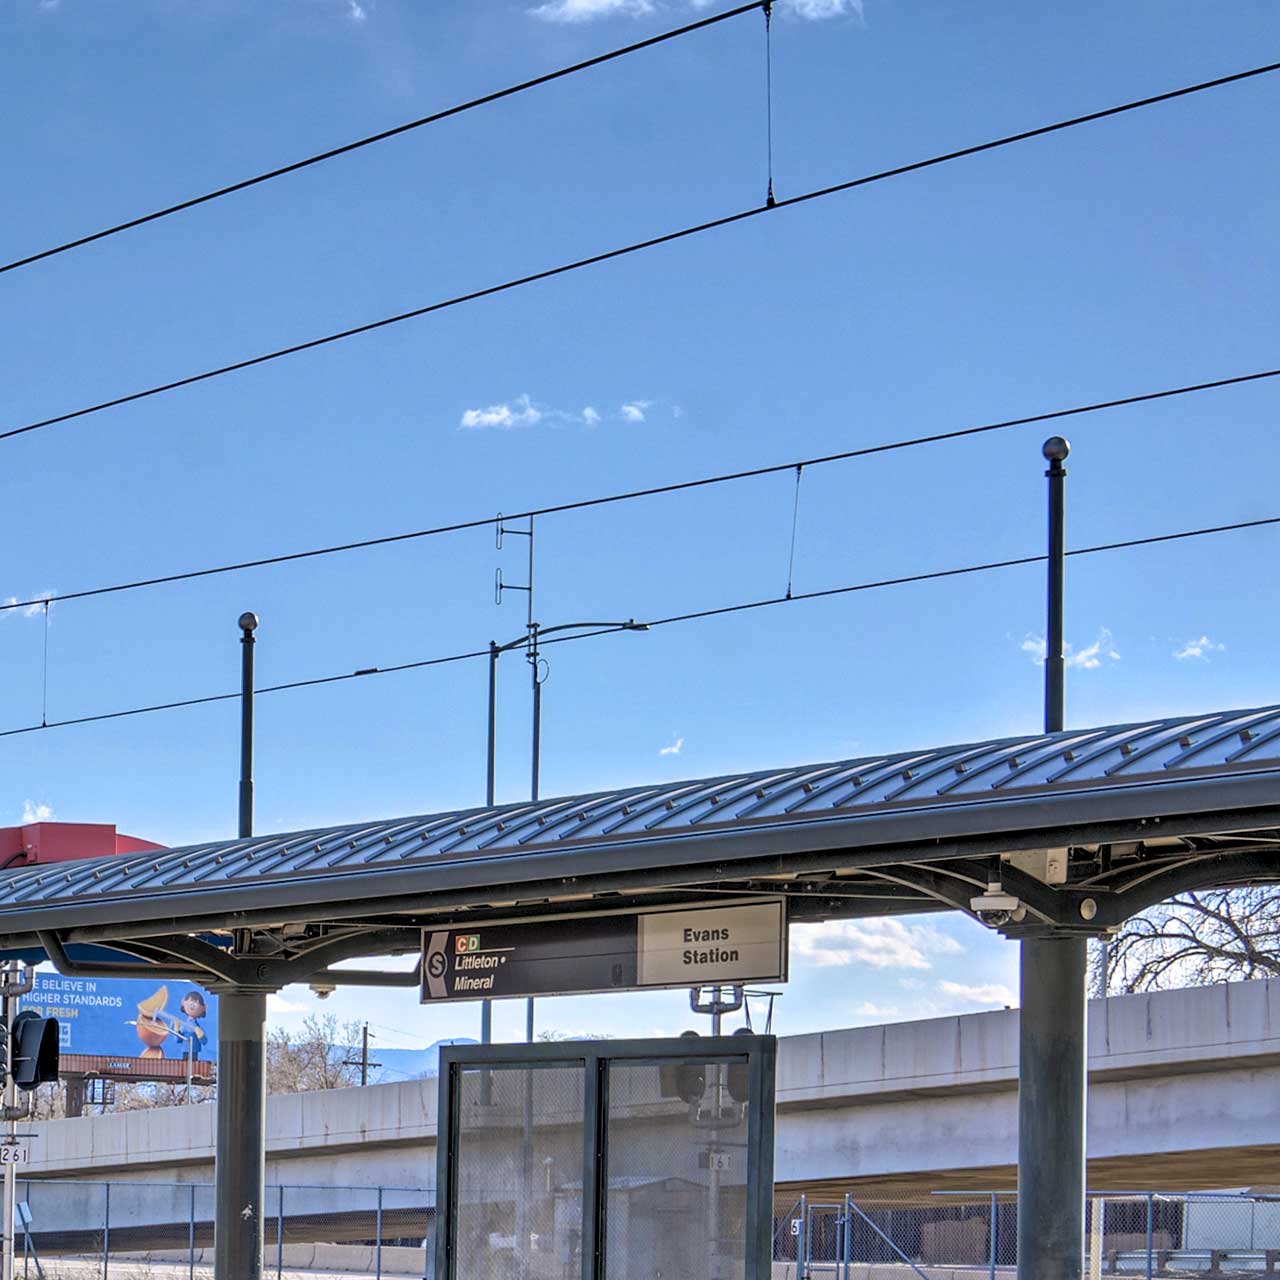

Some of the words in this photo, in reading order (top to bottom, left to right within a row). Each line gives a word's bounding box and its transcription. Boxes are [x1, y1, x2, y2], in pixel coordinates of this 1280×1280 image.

[683, 928, 729, 943] Evans
[457, 937, 467, 952] C
[468, 937, 478, 951] D
[454, 954, 499, 970] Littleton
[682, 948, 739, 965] Station
[429, 954, 444, 975] S
[42, 979, 83, 991] BELIEVE
[86, 982, 96, 992] IN
[454, 974, 495, 991] Mineral
[22, 992, 60, 1004] HIGHER
[63, 995, 122, 1007] STANDARDS
[46, 1006, 78, 1018] FRESH
[2, 1148, 26, 1162] 261
[791, 1220, 798, 1234] 6
